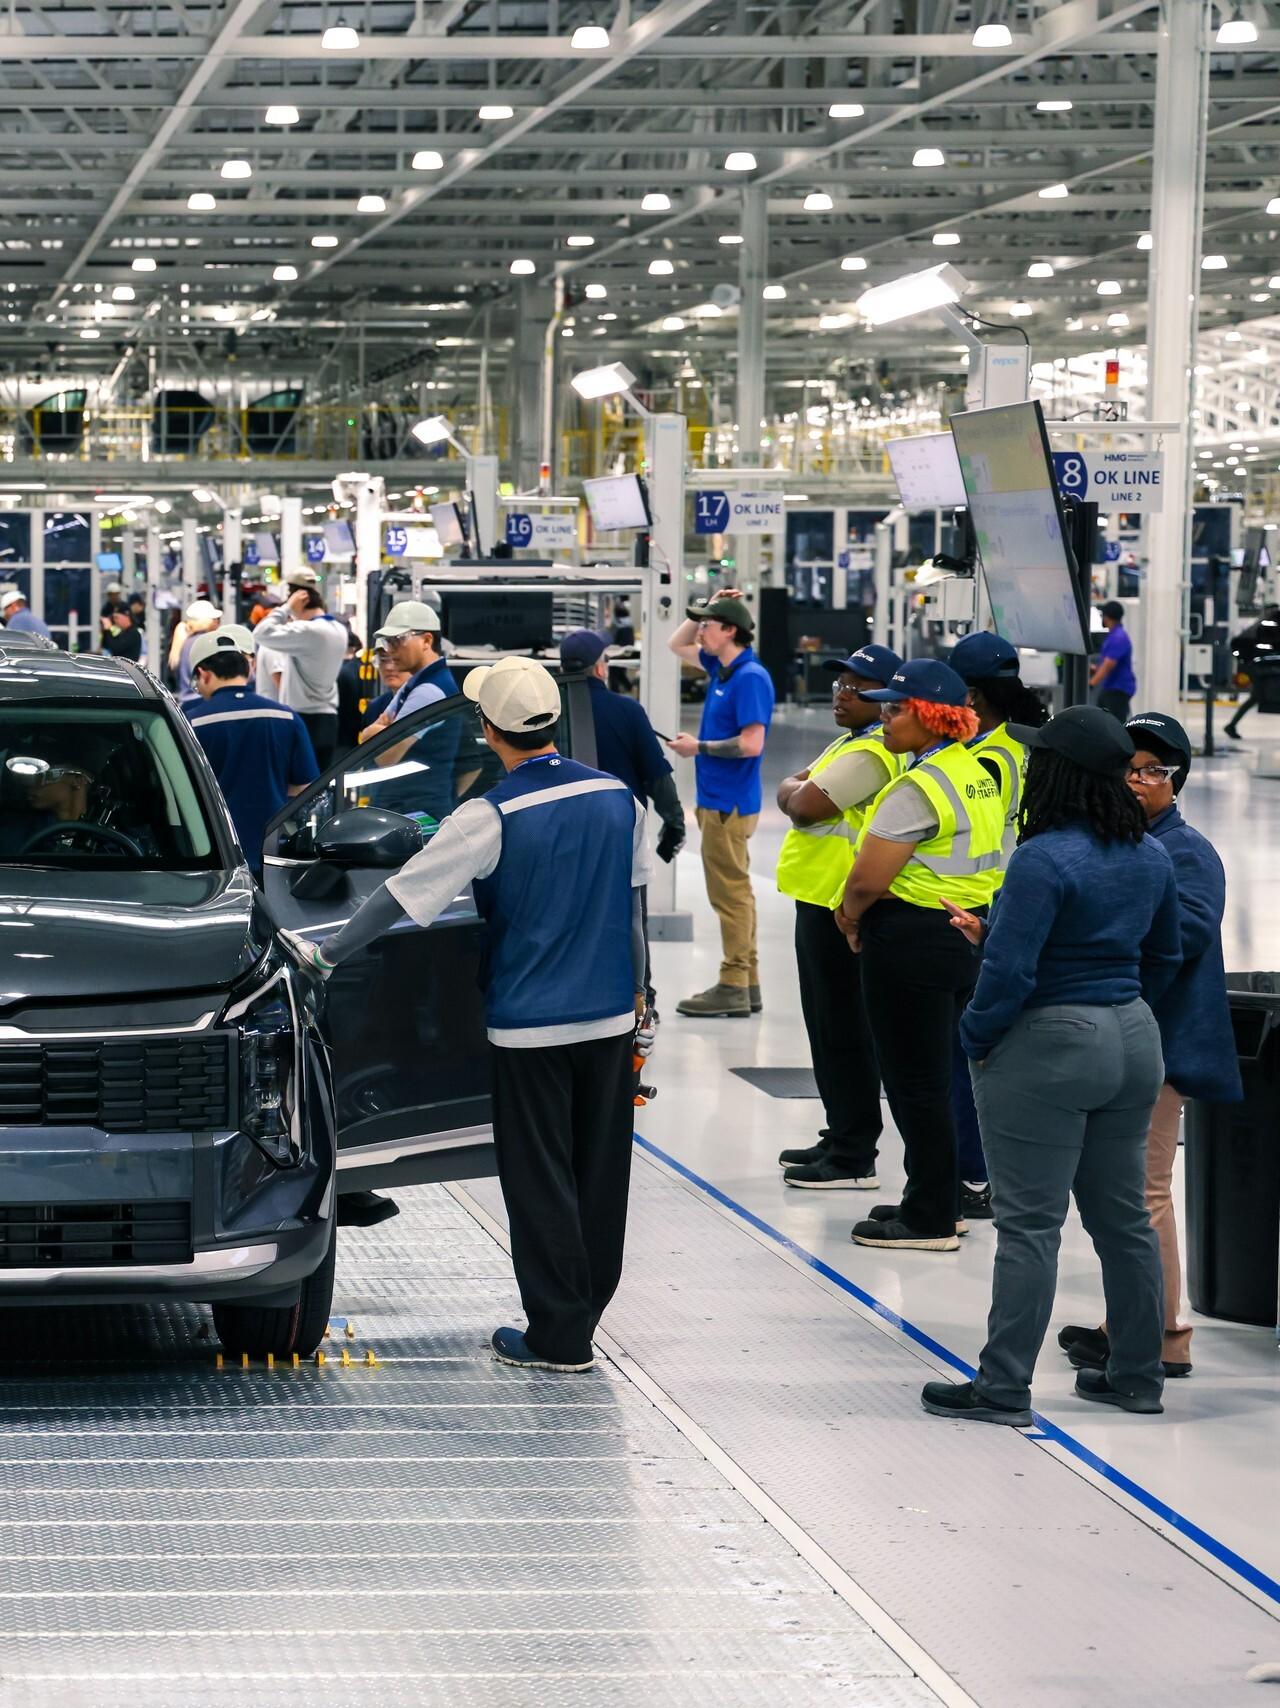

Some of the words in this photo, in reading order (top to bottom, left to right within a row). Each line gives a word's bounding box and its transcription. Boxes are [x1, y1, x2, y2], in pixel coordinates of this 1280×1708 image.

[1104, 454, 1127, 462] HMG
[1094, 470, 1118, 485] OK
[1124, 470, 1160, 485] LINE
[1111, 492, 1133, 501] LINE
[1136, 492, 1142, 501] 2
[698, 496, 726, 517] 17
[734, 504, 751, 515] OK
[755, 504, 781, 515] LINE
[508, 518, 531, 535] 16
[388, 530, 407, 546] 15
[976, 778, 995, 789] UNITE
